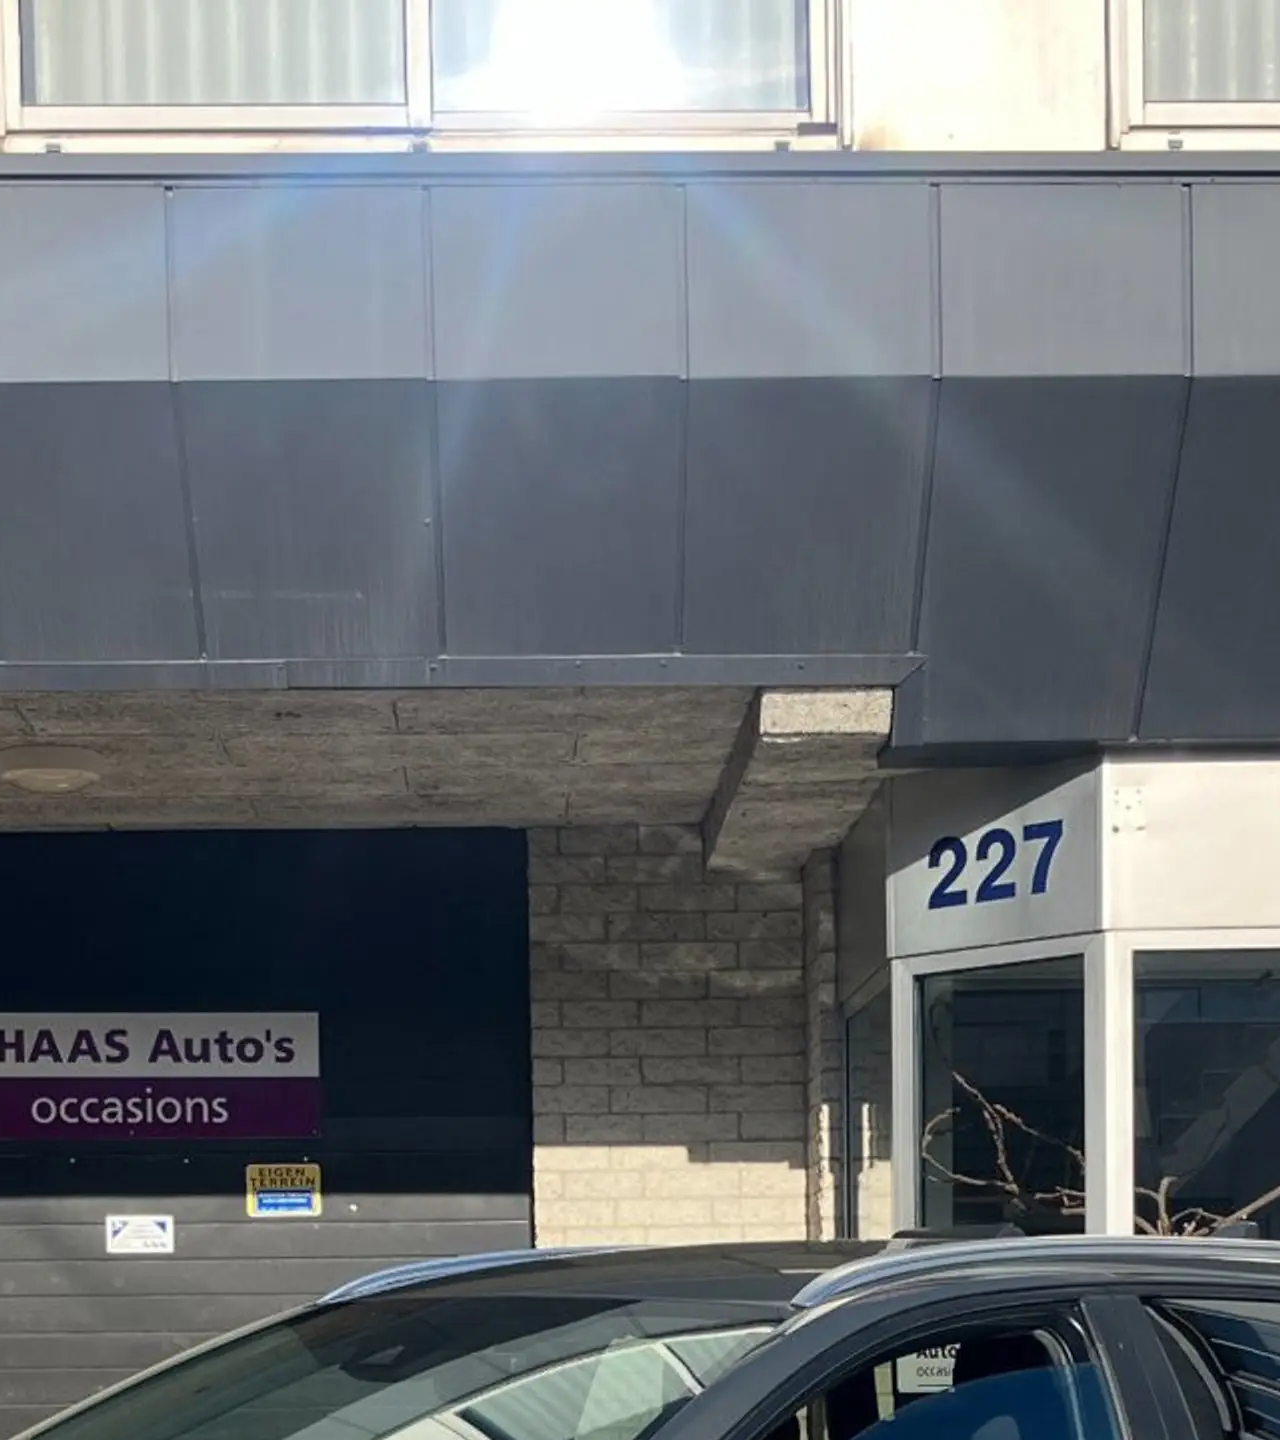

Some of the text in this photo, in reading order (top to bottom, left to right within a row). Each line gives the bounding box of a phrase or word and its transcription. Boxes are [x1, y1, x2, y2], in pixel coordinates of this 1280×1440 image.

[928, 820, 1064, 909] 227
[148, 1028, 296, 1064] Auto's
[31, 1087, 230, 1124] occasions
[258, 1167, 305, 1177] EIGEN
